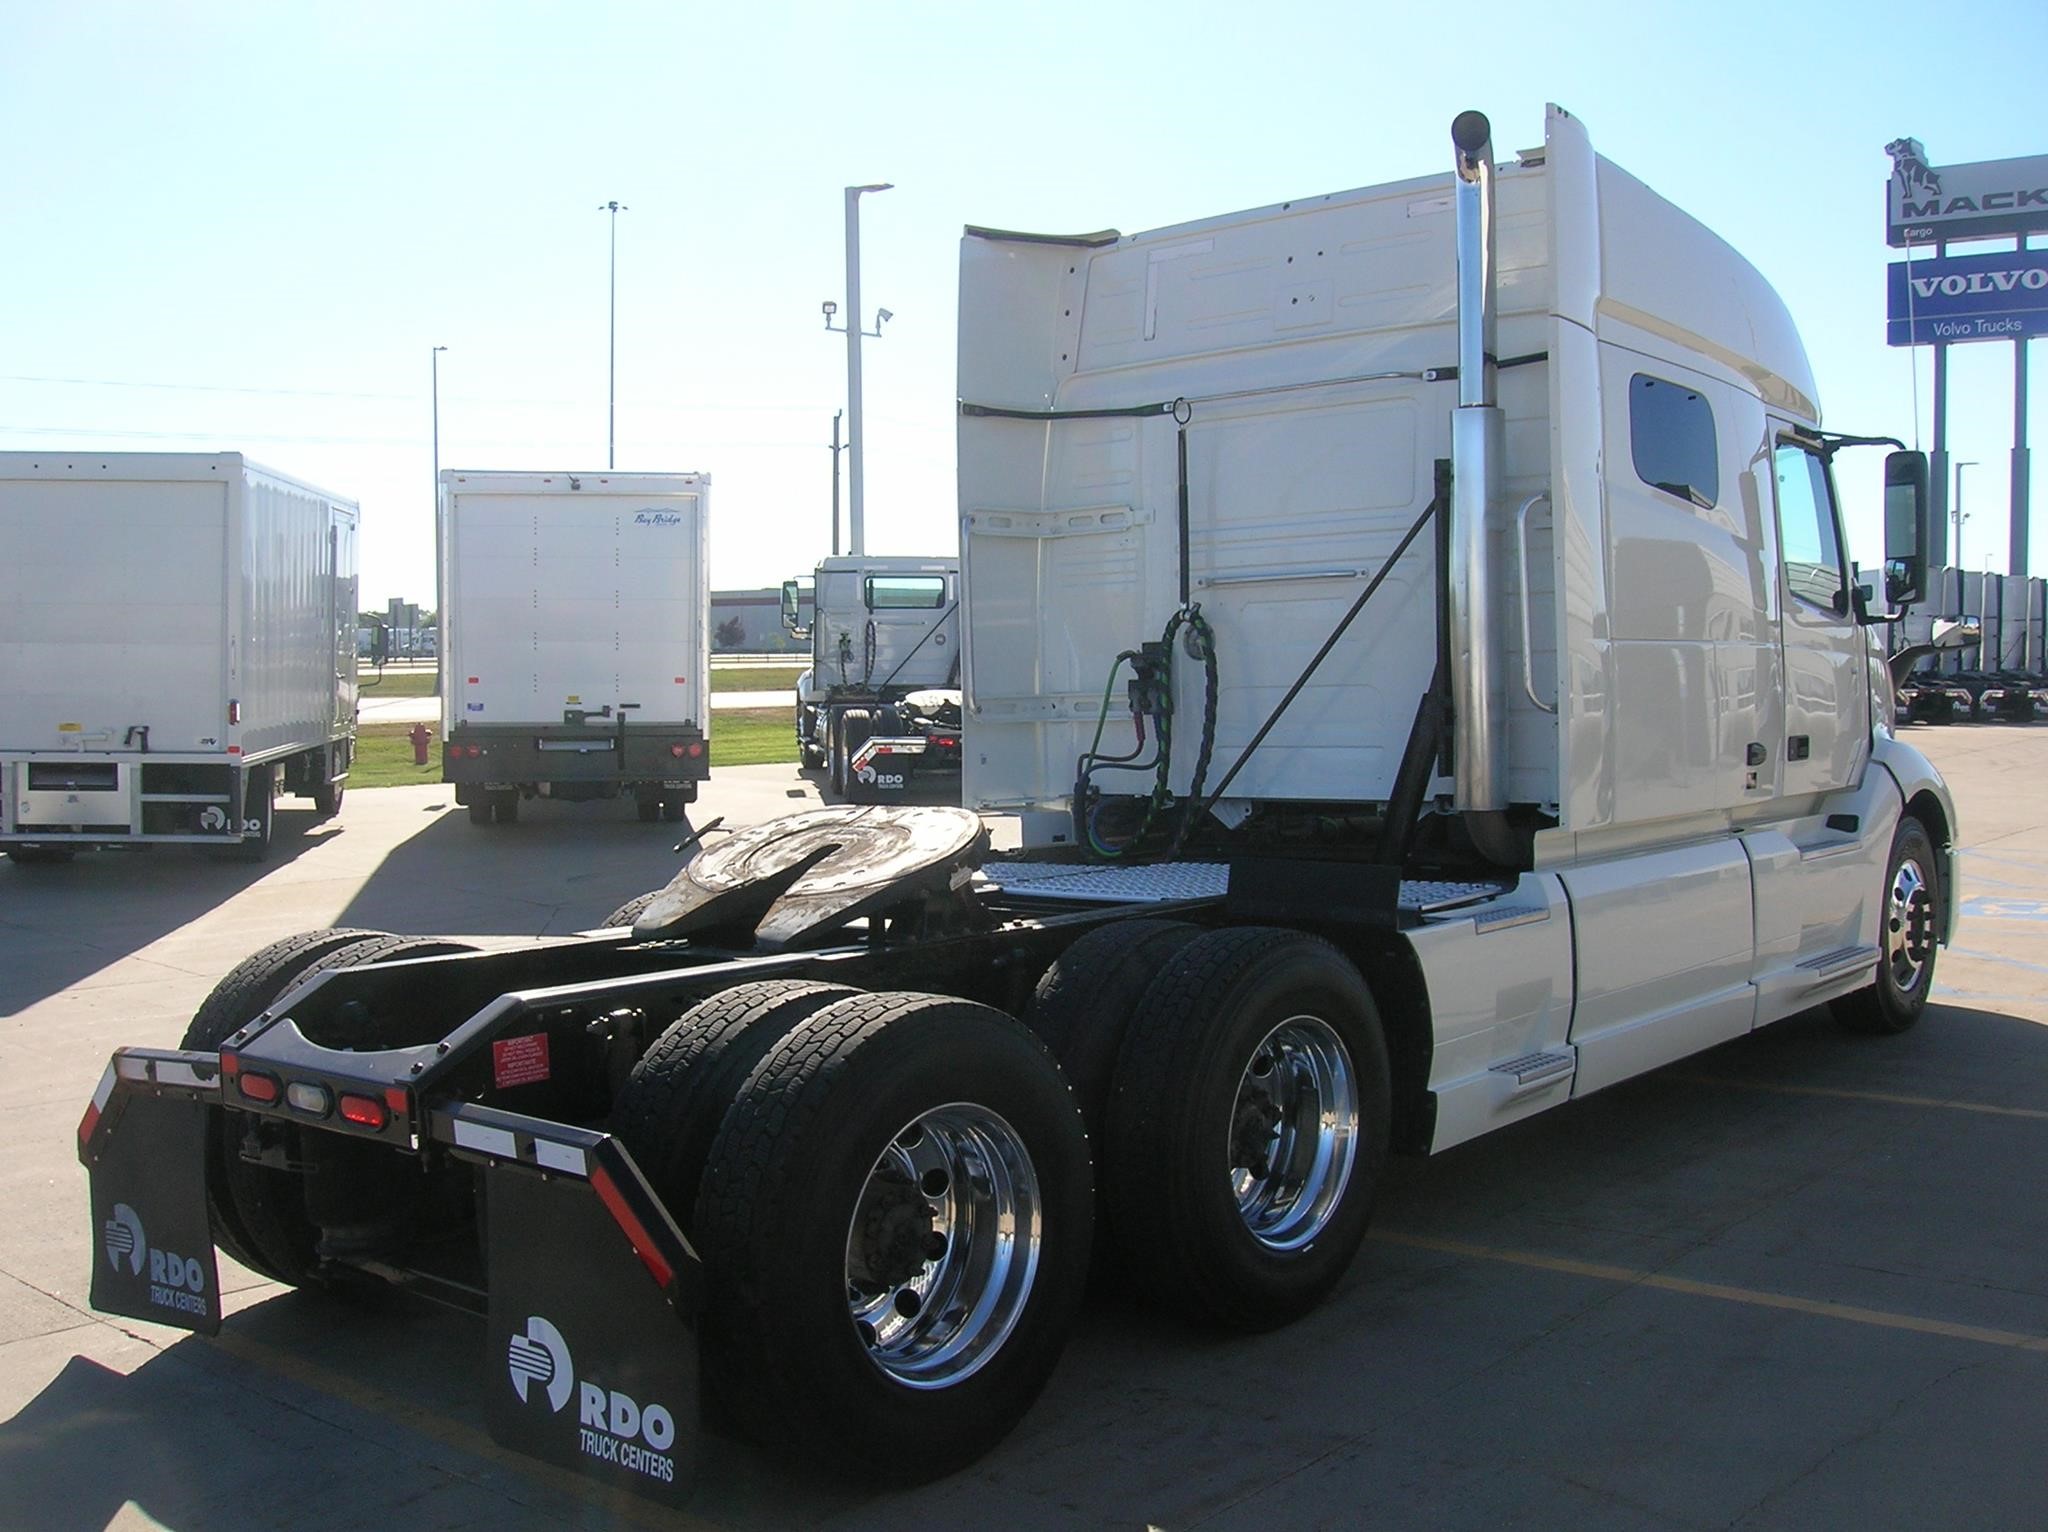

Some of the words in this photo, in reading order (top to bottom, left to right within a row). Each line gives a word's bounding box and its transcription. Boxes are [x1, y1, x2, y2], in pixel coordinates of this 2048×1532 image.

[1902, 188, 2048, 219] MACK
[1911, 269, 2048, 298] VOLVO
[1933, 322, 1971, 336] Volvo
[1974, 318, 2022, 334] Trucks
[878, 775, 903, 784] RDO
[150, 1248, 204, 1293] RDO
[150, 1285, 176, 1308] TRUCK
[175, 1291, 207, 1316] CENTERS
[580, 1380, 675, 1451] RDO
[580, 1428, 619, 1463] TRUCK
[620, 1441, 674, 1482] CENTERS
